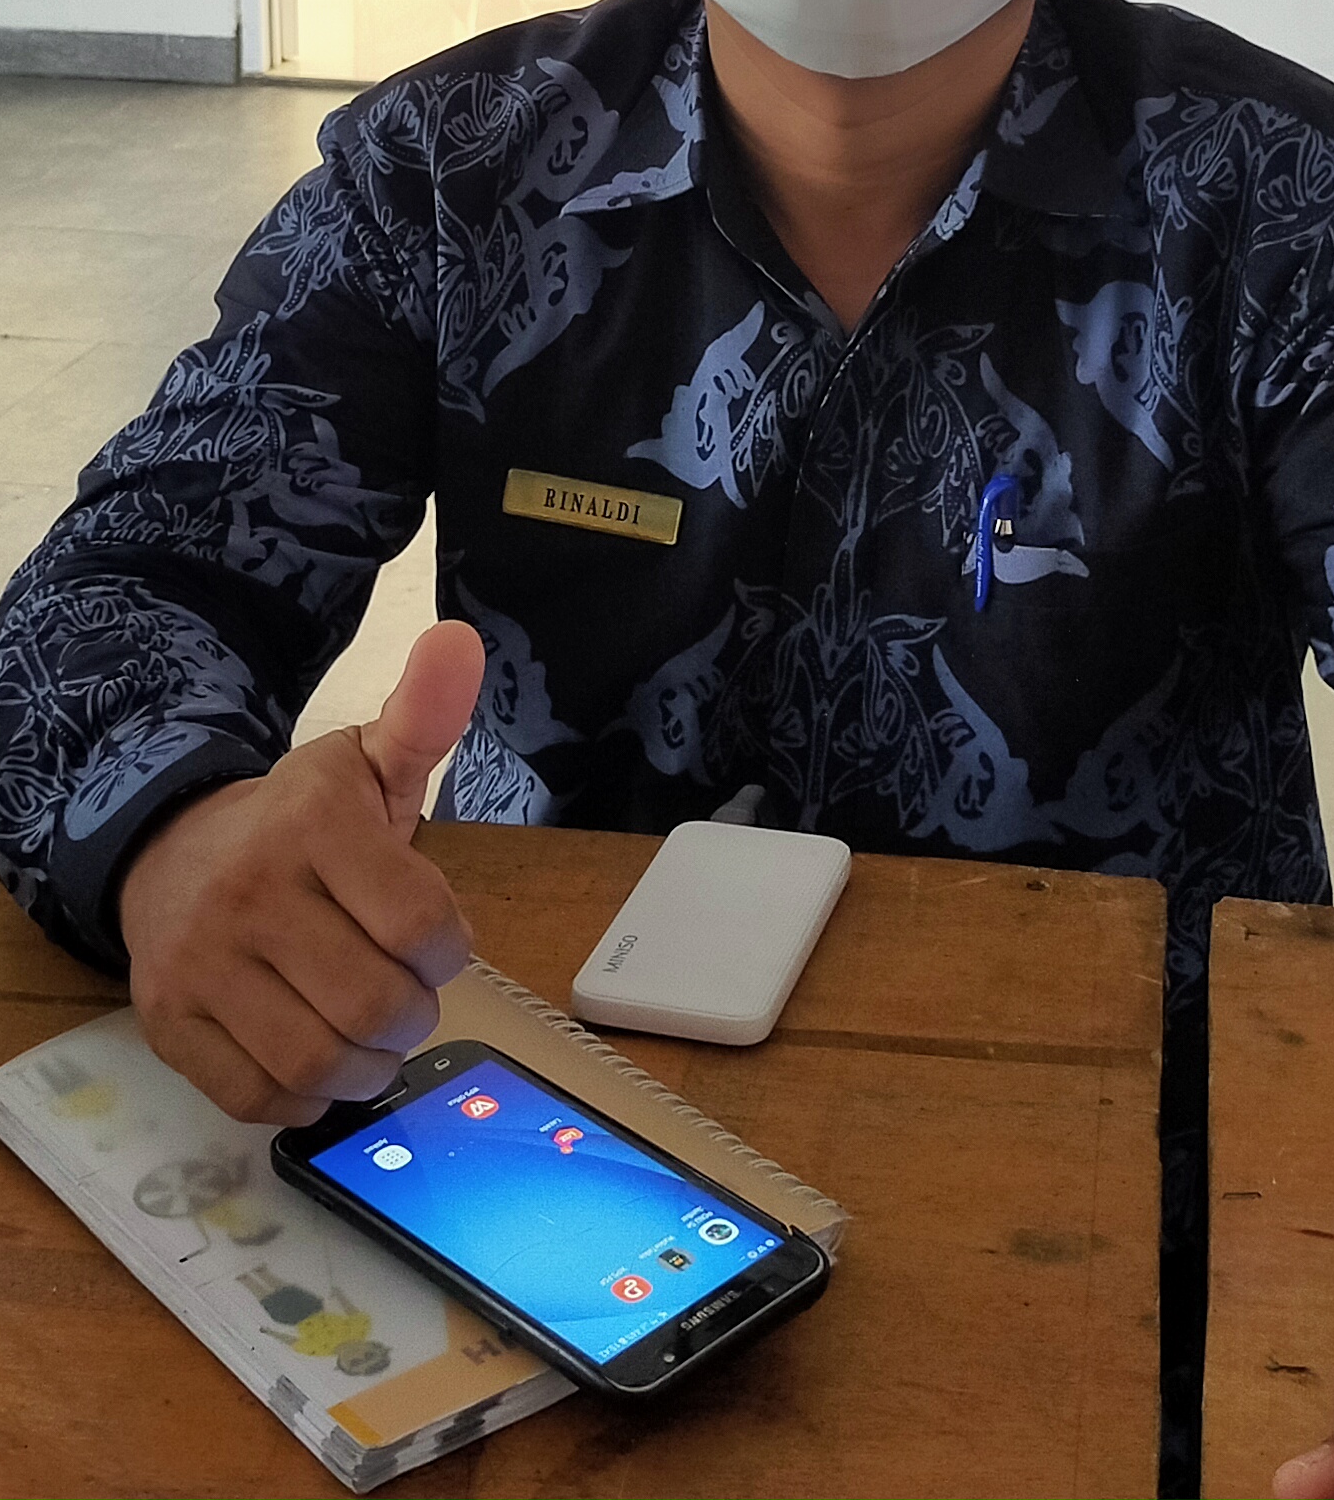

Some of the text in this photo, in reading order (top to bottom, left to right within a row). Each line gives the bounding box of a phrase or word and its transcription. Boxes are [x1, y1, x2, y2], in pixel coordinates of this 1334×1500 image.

[543, 487, 641, 525] RINALDI
[602, 934, 638, 974] MINISO
[680, 1289, 742, 1331] SAMSUNG
